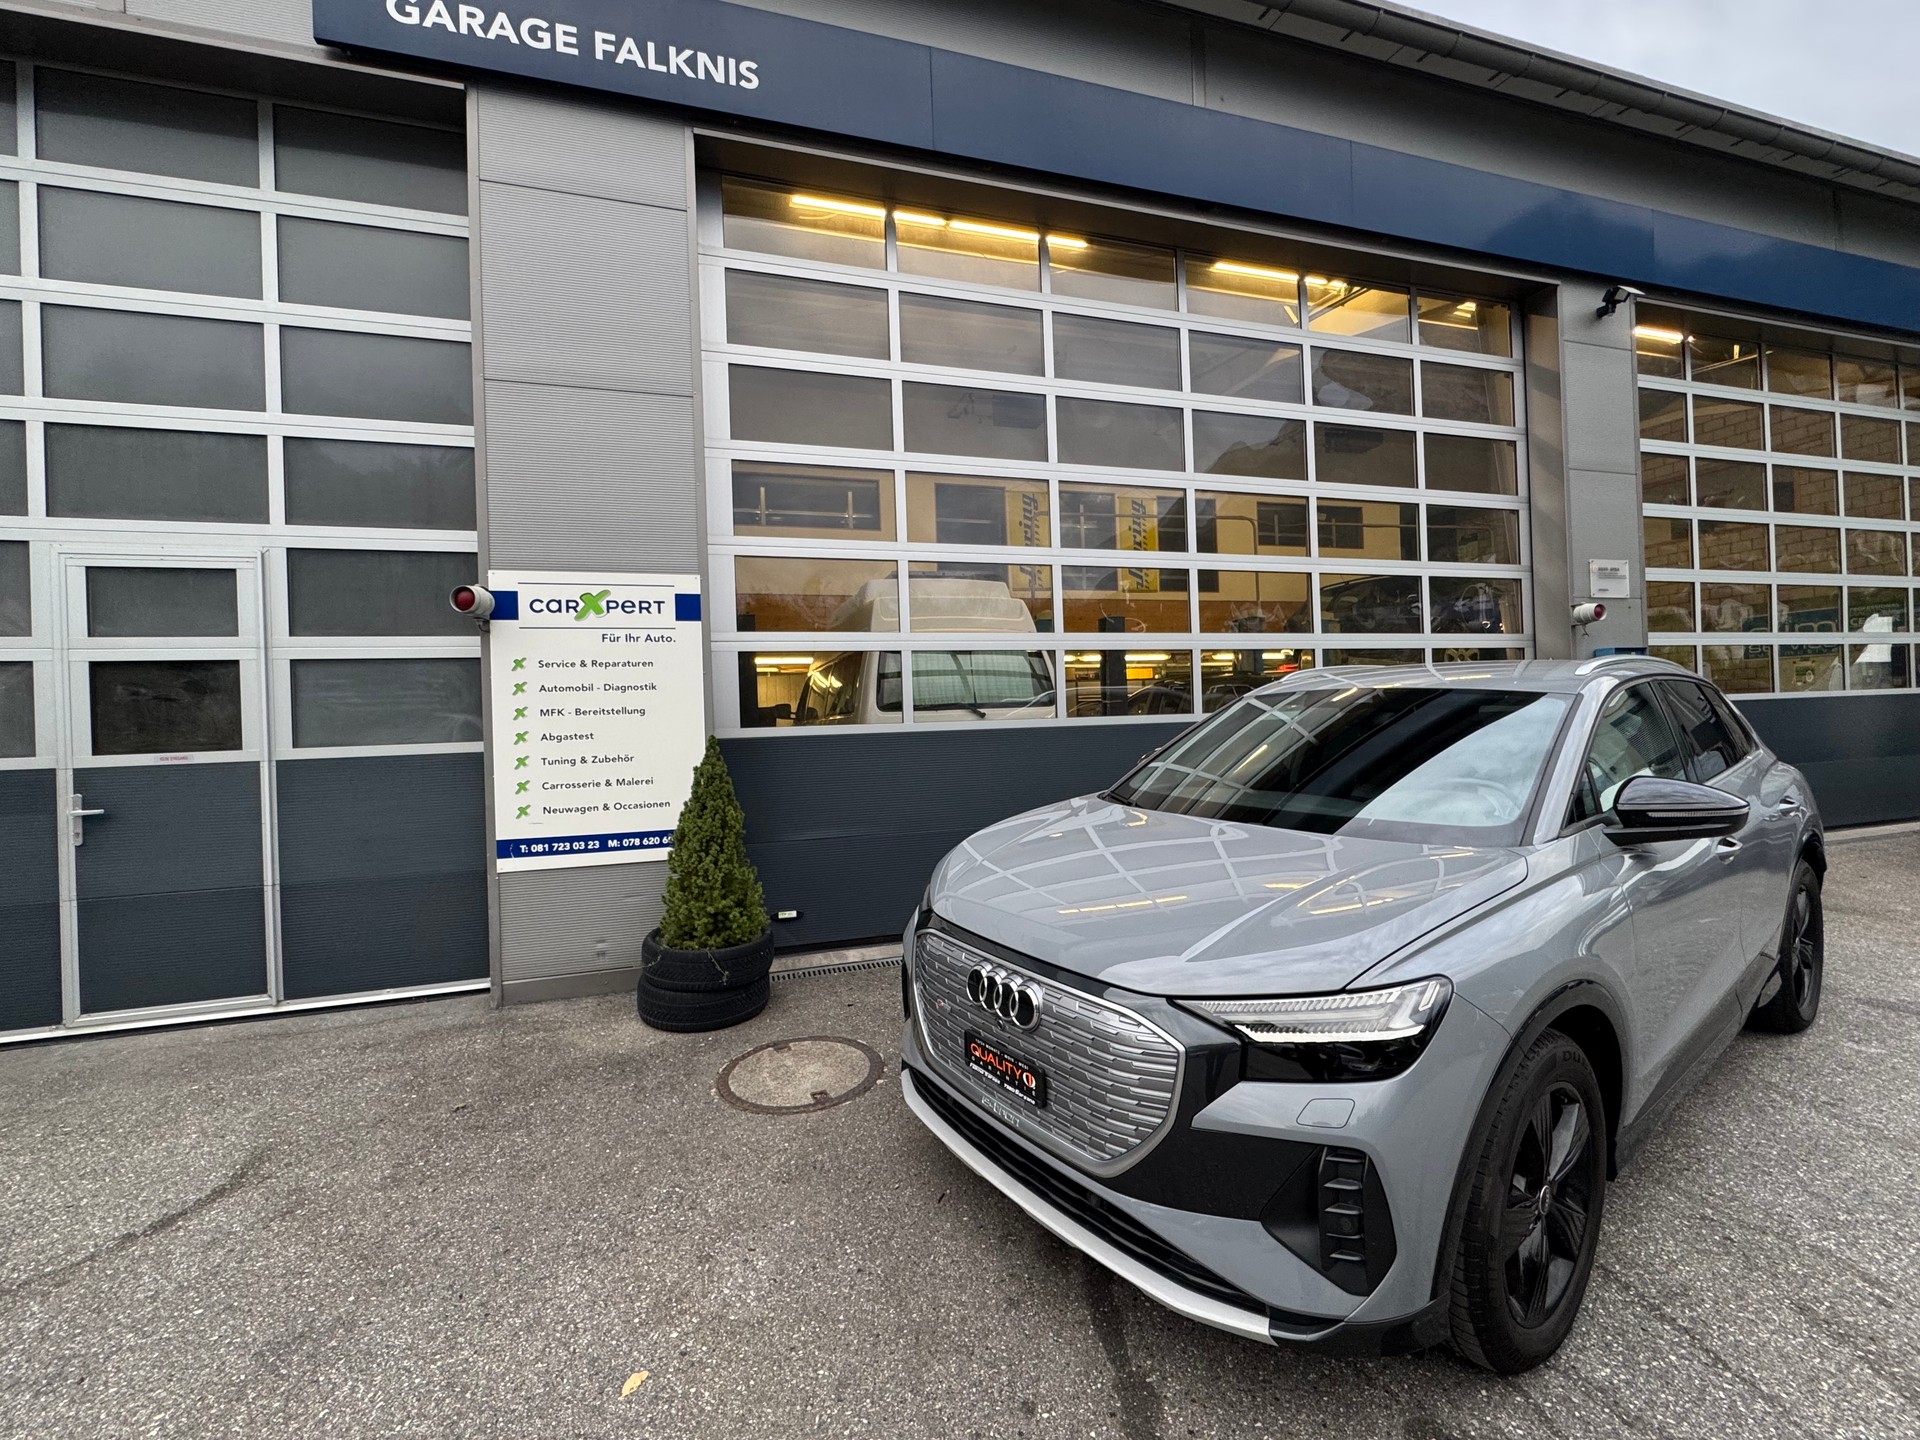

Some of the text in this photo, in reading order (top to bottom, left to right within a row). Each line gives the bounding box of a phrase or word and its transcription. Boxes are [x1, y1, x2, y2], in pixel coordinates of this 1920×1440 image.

[387, 0, 760, 91] GARAGE FALKNIS
[601, 633, 676, 643] Für Ihr Auto.
[538, 659, 654, 670] Service & Reparaturen
[539, 683, 594, 693] Automobil
[603, 682, 657, 694] Diagnostik
[539, 708, 565, 717] MFK
[574, 706, 646, 718] Bereitstellung
[540, 732, 594, 744] Abgastest
[541, 754, 634, 767] Tuning & Zubehör
[542, 777, 654, 791] Carrosserie & Malerei
[543, 800, 671, 815] Neuwagen & Occasionen
[520, 845, 528, 854] T:
[530, 843, 549, 852] 081
[552, 842, 570, 851] 723
[573, 841, 585, 850] 03
[587, 840, 600, 849] 23
[608, 839, 620, 848] M:
[623, 838, 640, 847] 078
[642, 837, 660, 846] 620
[970, 1043, 1022, 1080] QUALITY
